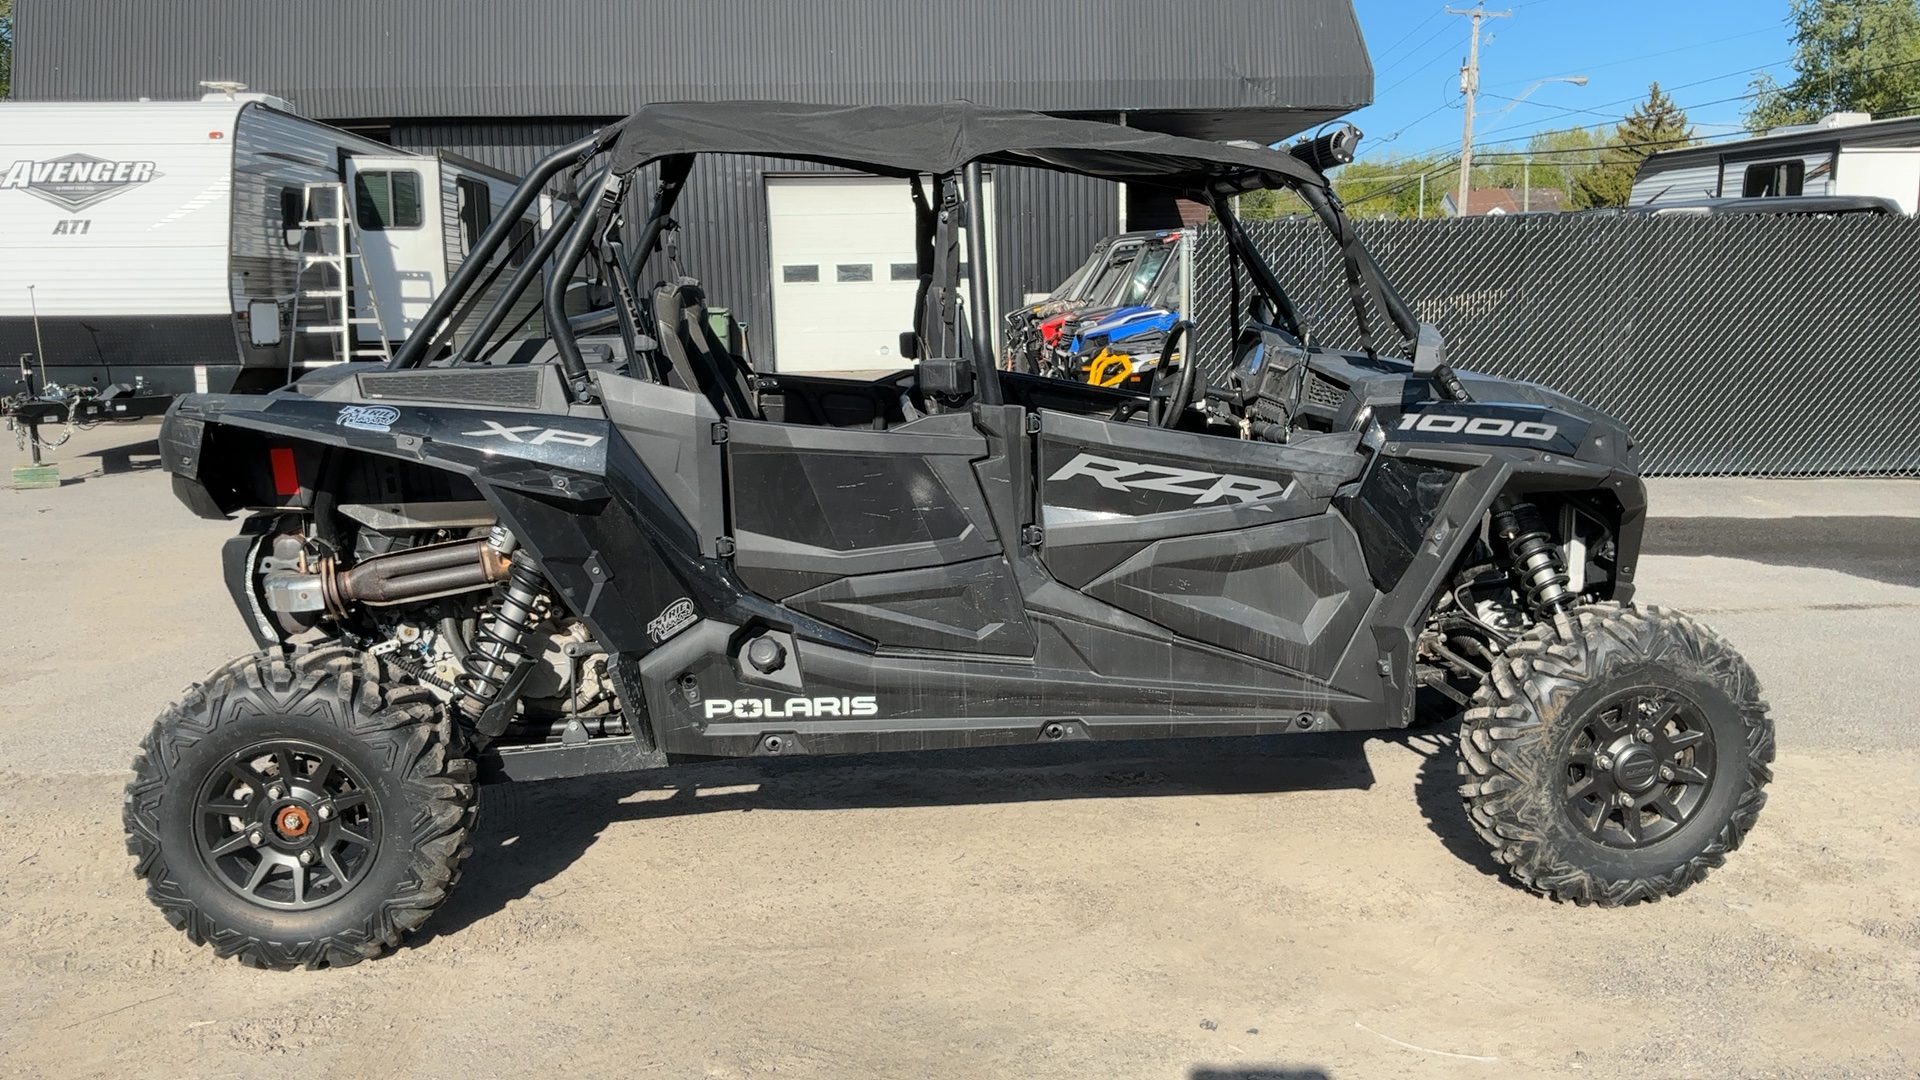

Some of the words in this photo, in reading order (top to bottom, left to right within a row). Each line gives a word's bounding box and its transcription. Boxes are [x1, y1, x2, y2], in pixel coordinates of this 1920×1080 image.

[0, 160, 156, 189] AVENGER
[52, 219, 91, 235] ATI
[461, 419, 604, 447] XP
[1397, 413, 1558, 441] 1000
[1047, 452, 1285, 513] RZR
[648, 601, 690, 633] ESTRIE
[704, 696, 879, 719] POLARIS
